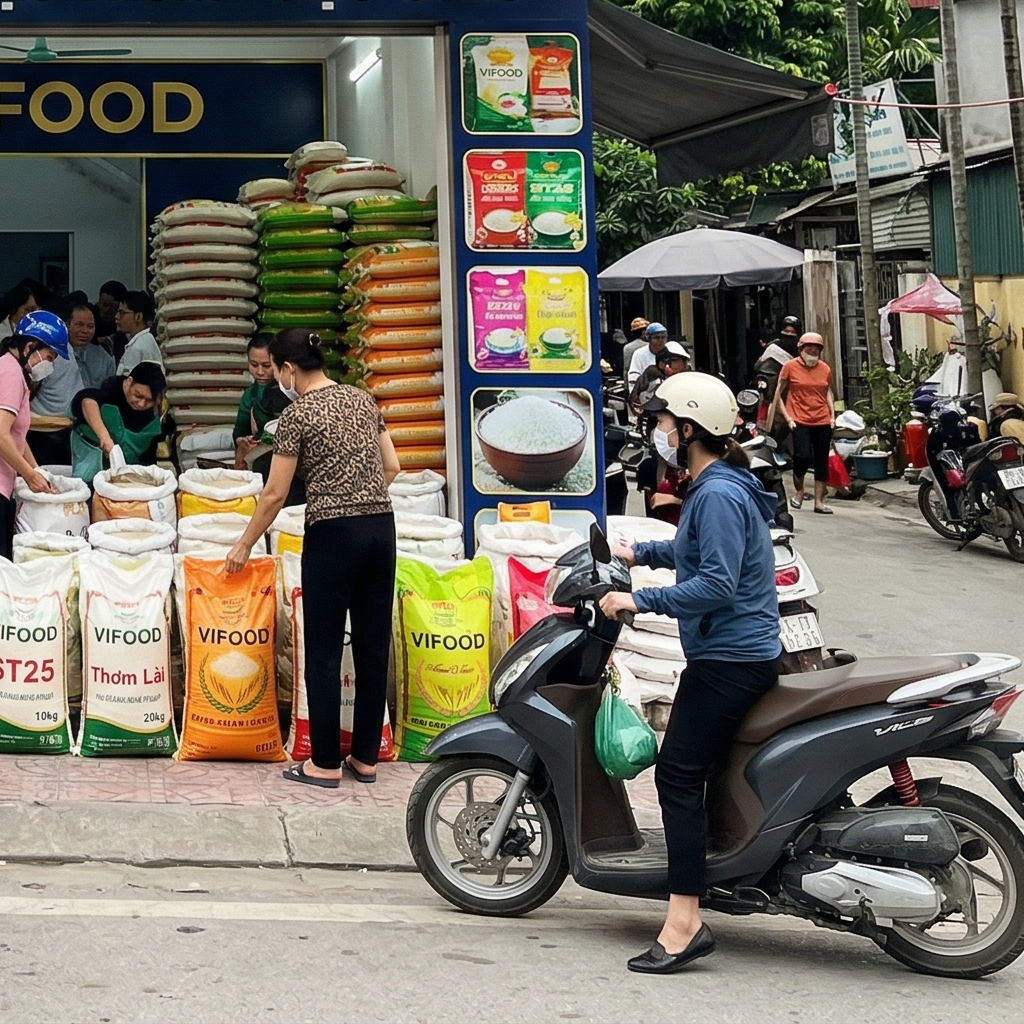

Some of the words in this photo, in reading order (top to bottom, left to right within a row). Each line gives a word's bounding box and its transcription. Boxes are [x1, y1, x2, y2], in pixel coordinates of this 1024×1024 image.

[479, 67, 524, 78] VIFOOD
[94, 626, 162, 646] VIFOOD
[198, 626, 270, 646] VIFOOD
[411, 631, 485, 651] VIFOOD
[91, 665, 137, 686] Thơm
[143, 666, 165, 685] Lài
